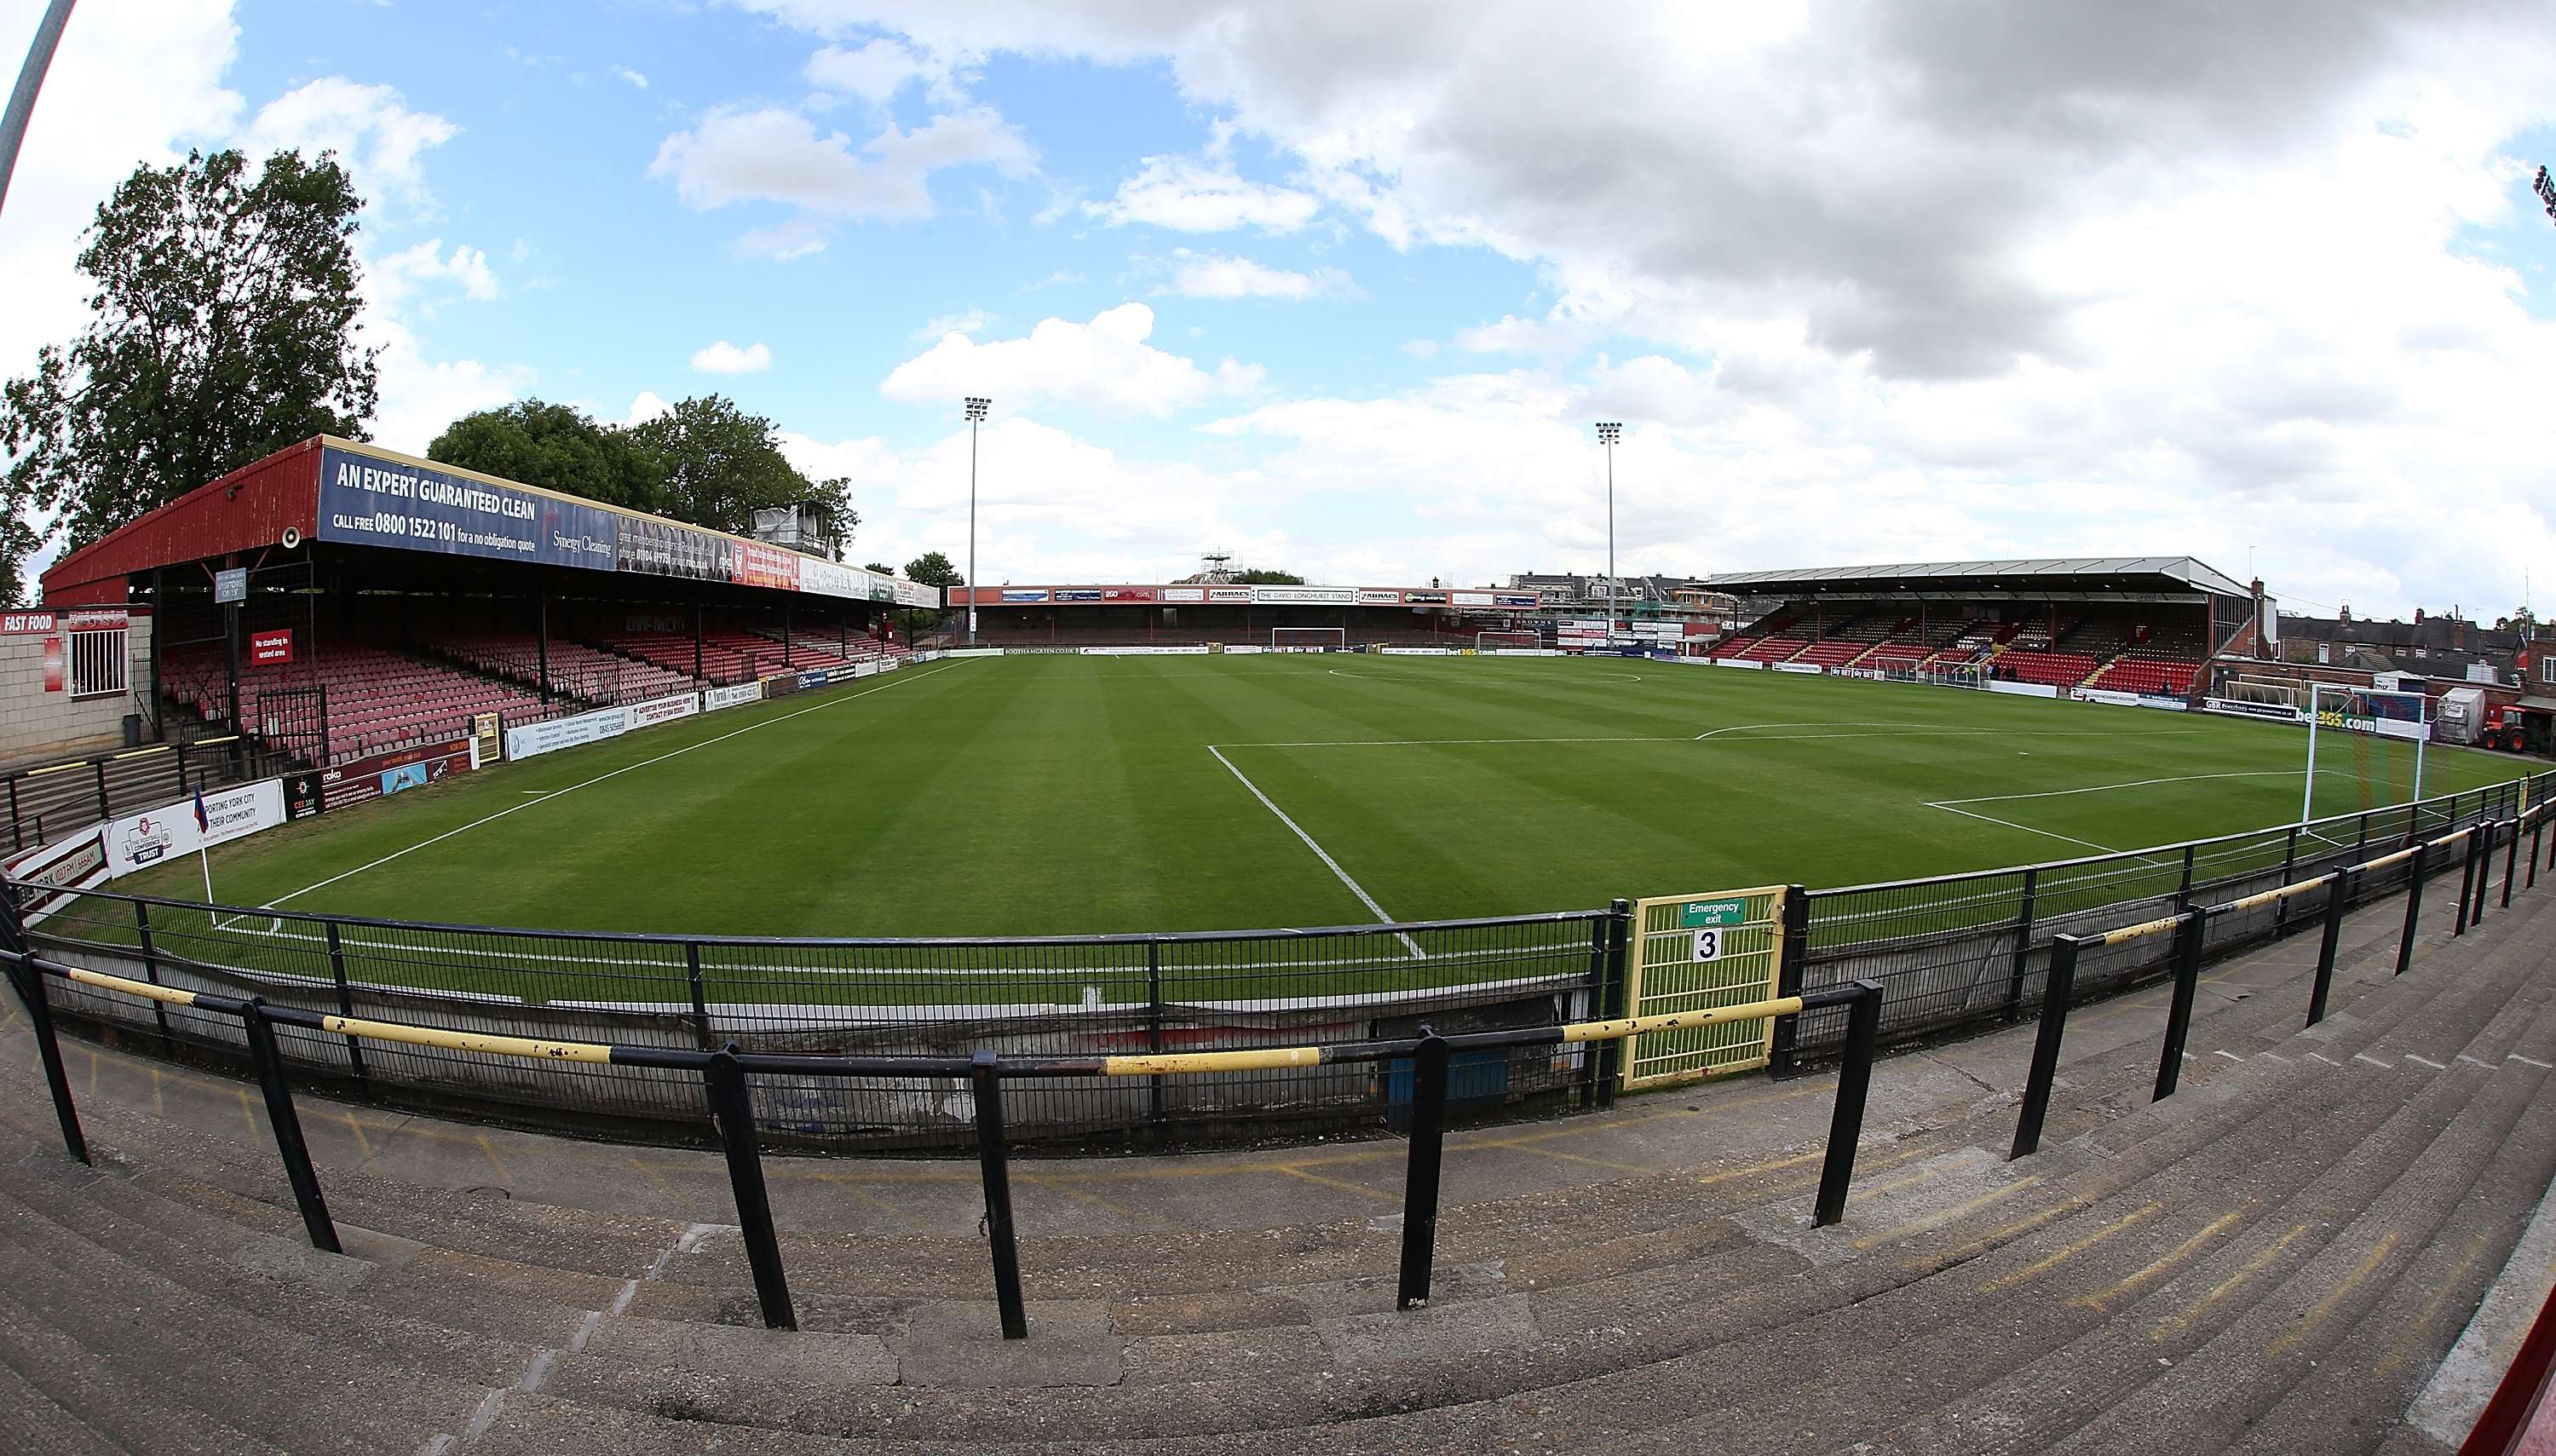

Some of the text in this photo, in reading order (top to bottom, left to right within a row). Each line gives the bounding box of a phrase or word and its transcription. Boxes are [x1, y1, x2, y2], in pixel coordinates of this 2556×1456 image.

[337, 463, 535, 521] AN EXPERT GUARANTEED CLEAN
[333, 512, 535, 553] CALL FREE 0800 1522 101 for a no obligation quote
[554, 531, 611, 557] Synergy Cleaning
[217, 579, 244, 591] VISITORS
[4, 614, 52, 631] FAST FOOD
[262, 636, 282, 647] standing
[283, 636, 288, 645] in
[258, 648, 285, 659] seated area
[1447, 647, 1496, 655] bet365.com
[1854, 669, 1862, 678] sky
[639, 704, 657, 713] ADVERTISE
[667, 699, 682, 707] BUSINESS
[2206, 700, 2221, 709] GBR
[647, 711, 663, 721] CONTACT
[324, 768, 342, 781] roko
[204, 792, 256, 814] PORTING YORK CITY
[294, 800, 305, 809] CEE
[305, 797, 315, 807] JAY
[210, 807, 256, 829] THEIR COMMUNITY
[134, 839, 161, 851] CONFERENCE
[138, 848, 159, 861] TRUST
[37, 872, 55, 887] ORK
[1689, 902, 1739, 915] Emergency
[1705, 914, 1722, 924] exit
[1699, 931, 1716, 958] 3
